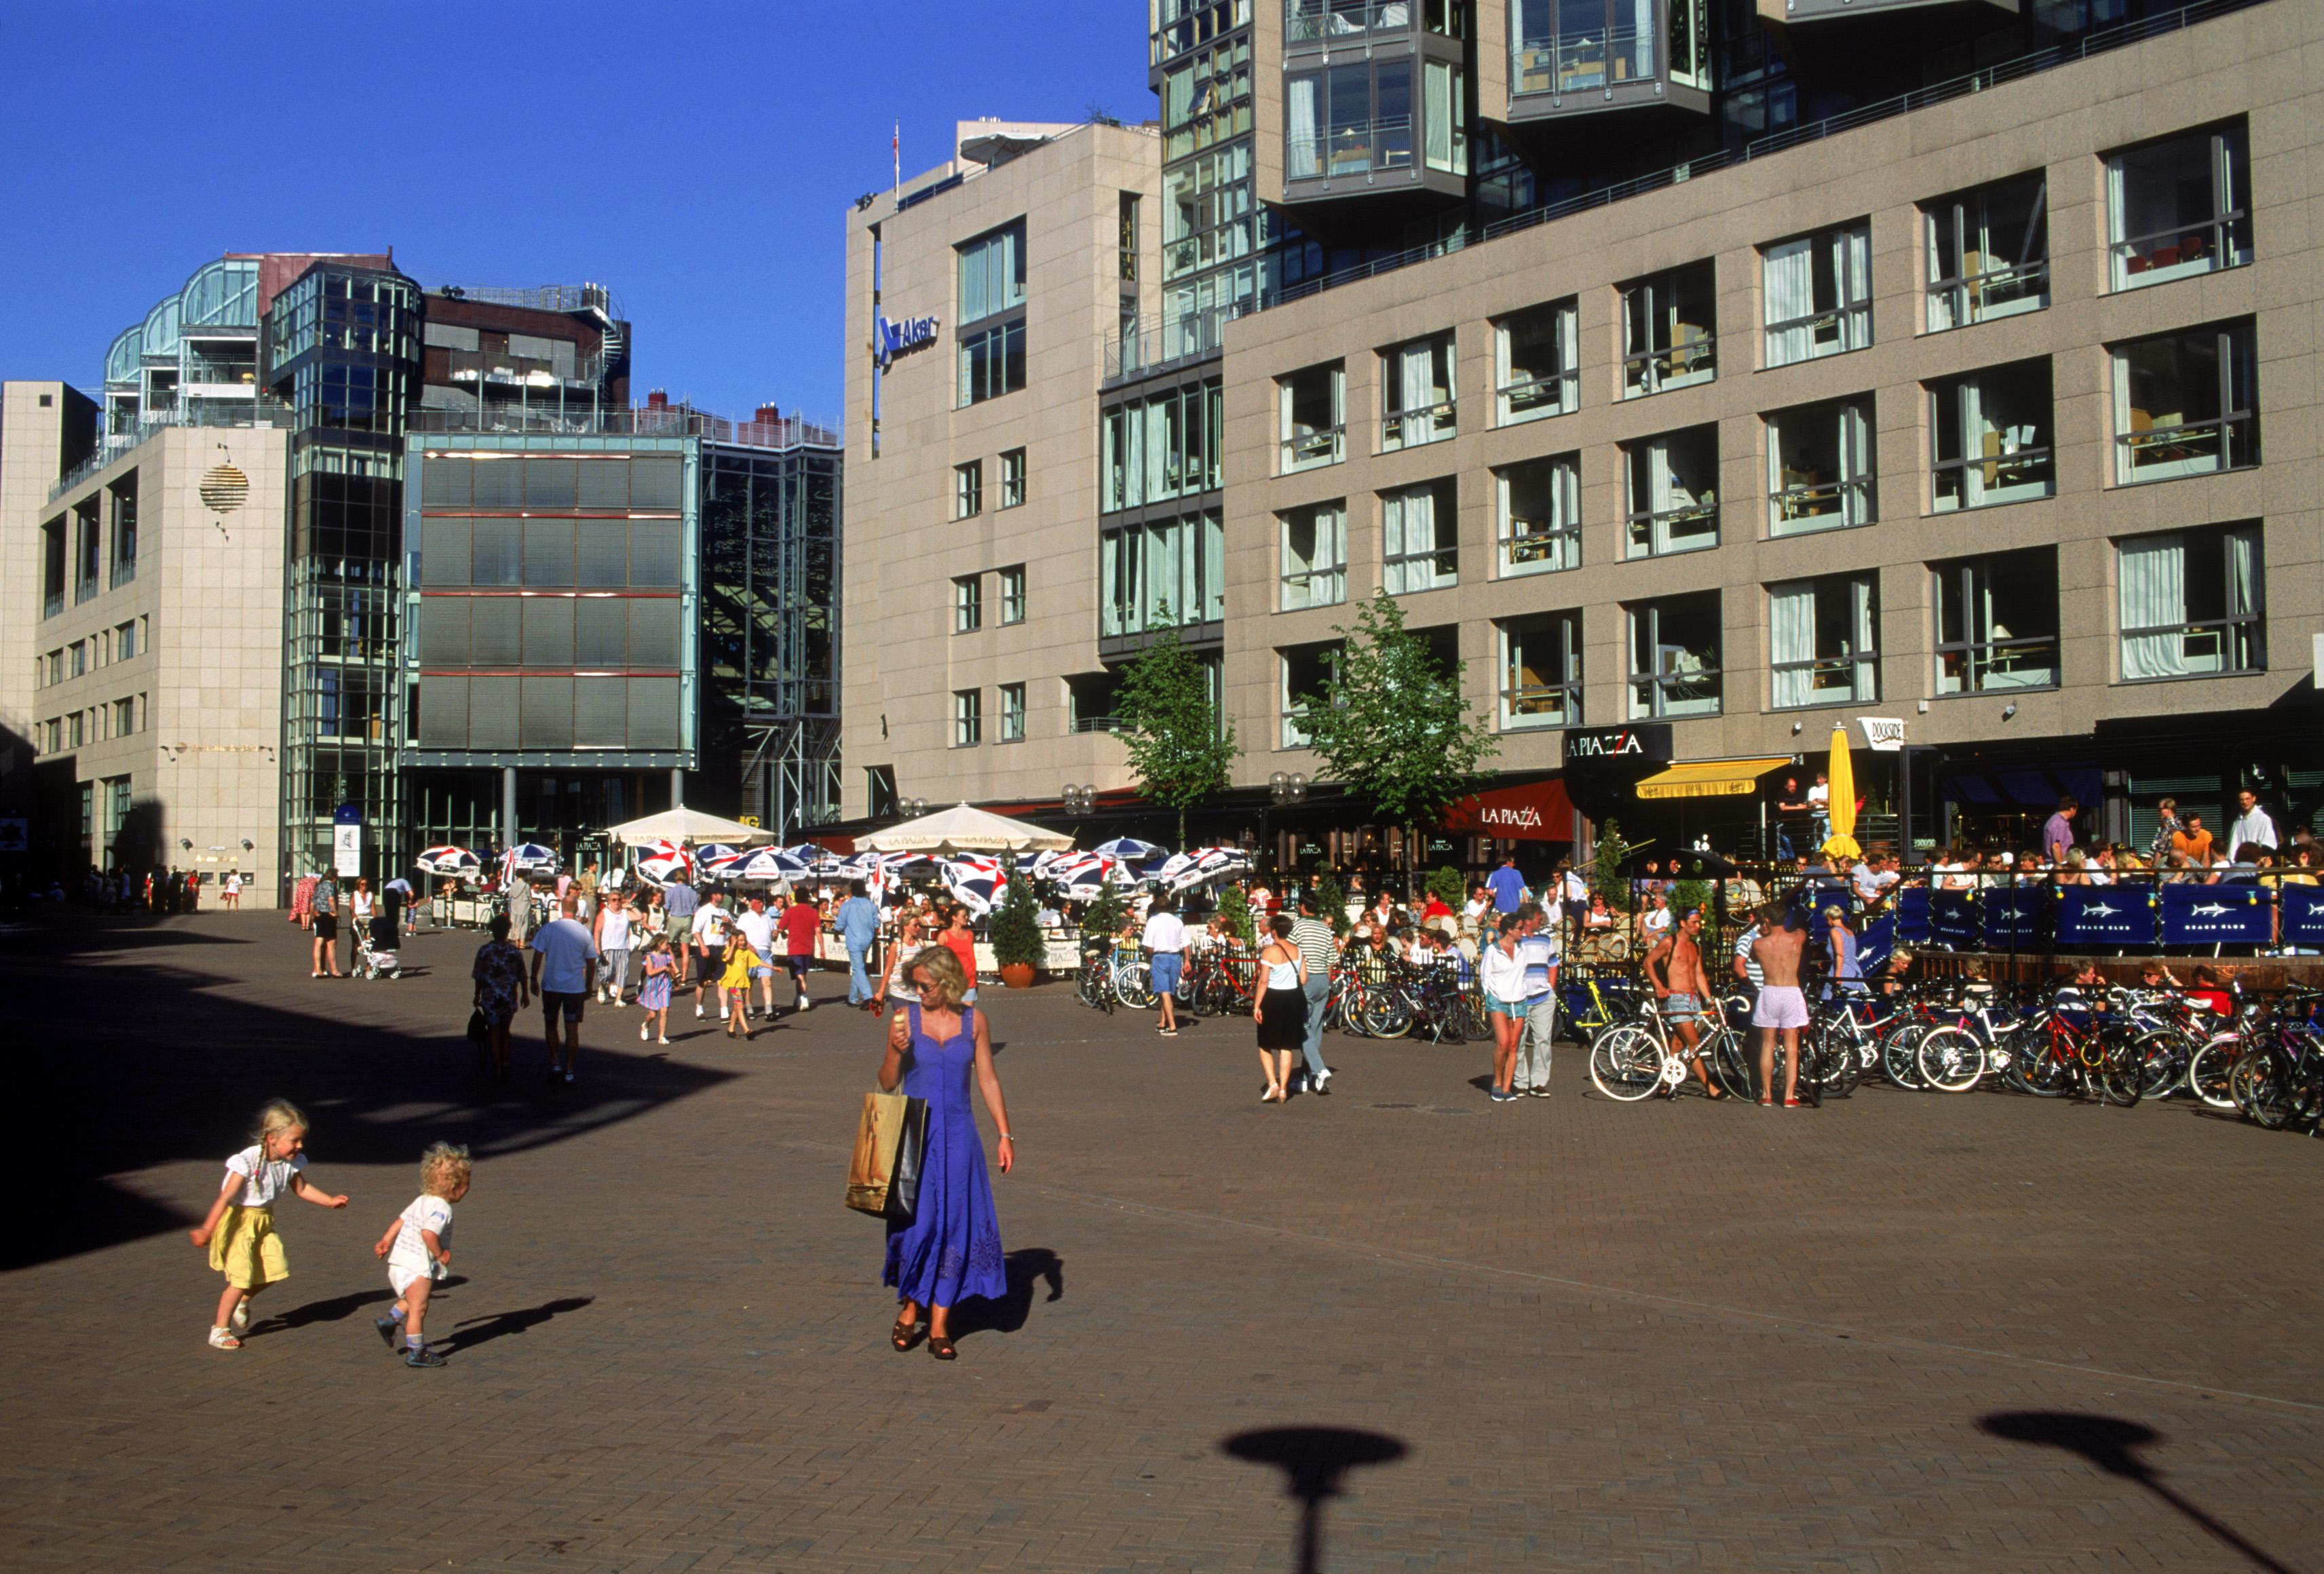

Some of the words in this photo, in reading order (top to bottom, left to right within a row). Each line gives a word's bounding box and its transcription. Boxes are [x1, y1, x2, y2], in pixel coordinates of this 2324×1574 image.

[902, 315, 934, 347] Aker
[1873, 722, 1901, 738] DOCKSIDE
[1566, 739, 1578, 757] A
[1580, 729, 1643, 759] PIAZZA
[1482, 808, 1499, 823] LA
[1502, 807, 1542, 830] PIAZZA
[584, 842, 601, 850] PIAZZA
[890, 837, 900, 845] LA
[901, 836, 928, 845] PIAZZA
[1050, 951, 1080, 963] PIAZZA
